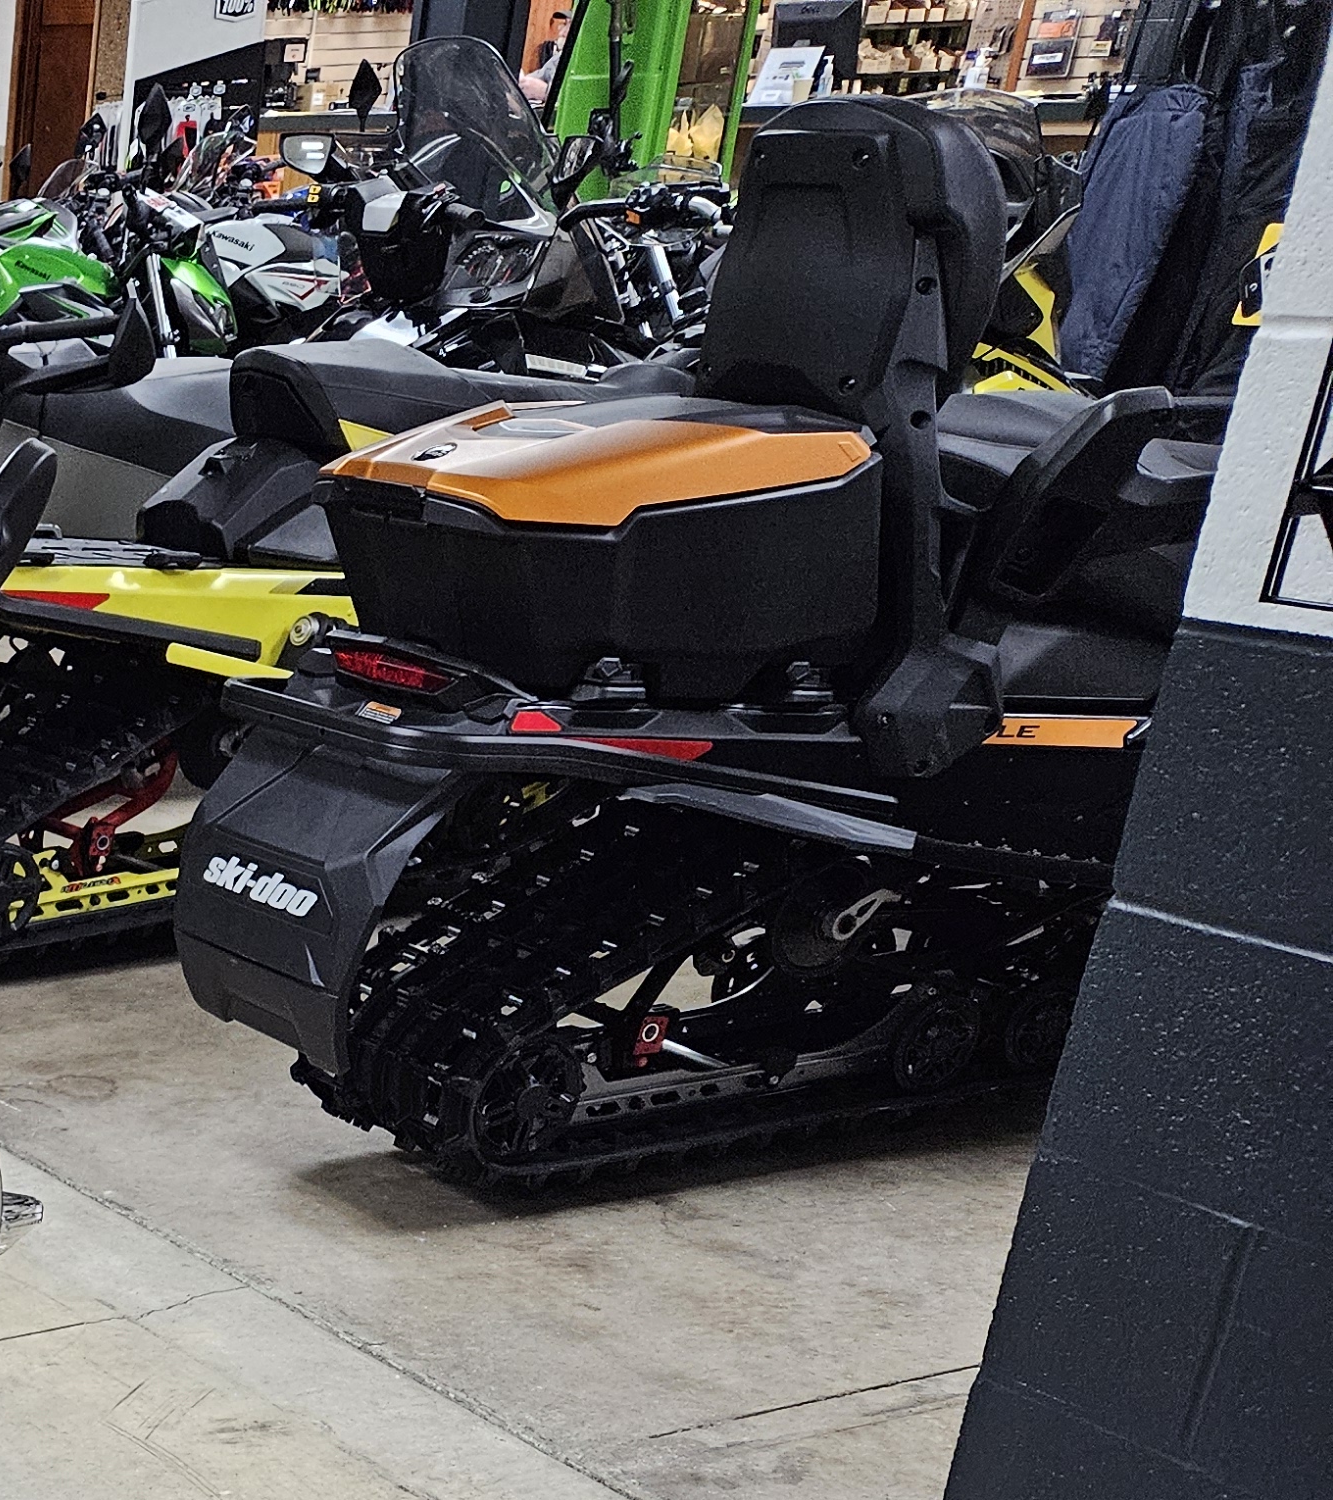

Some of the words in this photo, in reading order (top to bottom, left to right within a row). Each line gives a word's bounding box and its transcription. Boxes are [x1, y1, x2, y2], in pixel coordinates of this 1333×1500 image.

[212, 230, 255, 252] Kawasaki
[14, 259, 51, 281] Kawasaki
[996, 725, 1040, 738] LE
[203, 855, 319, 917] ski-doo
